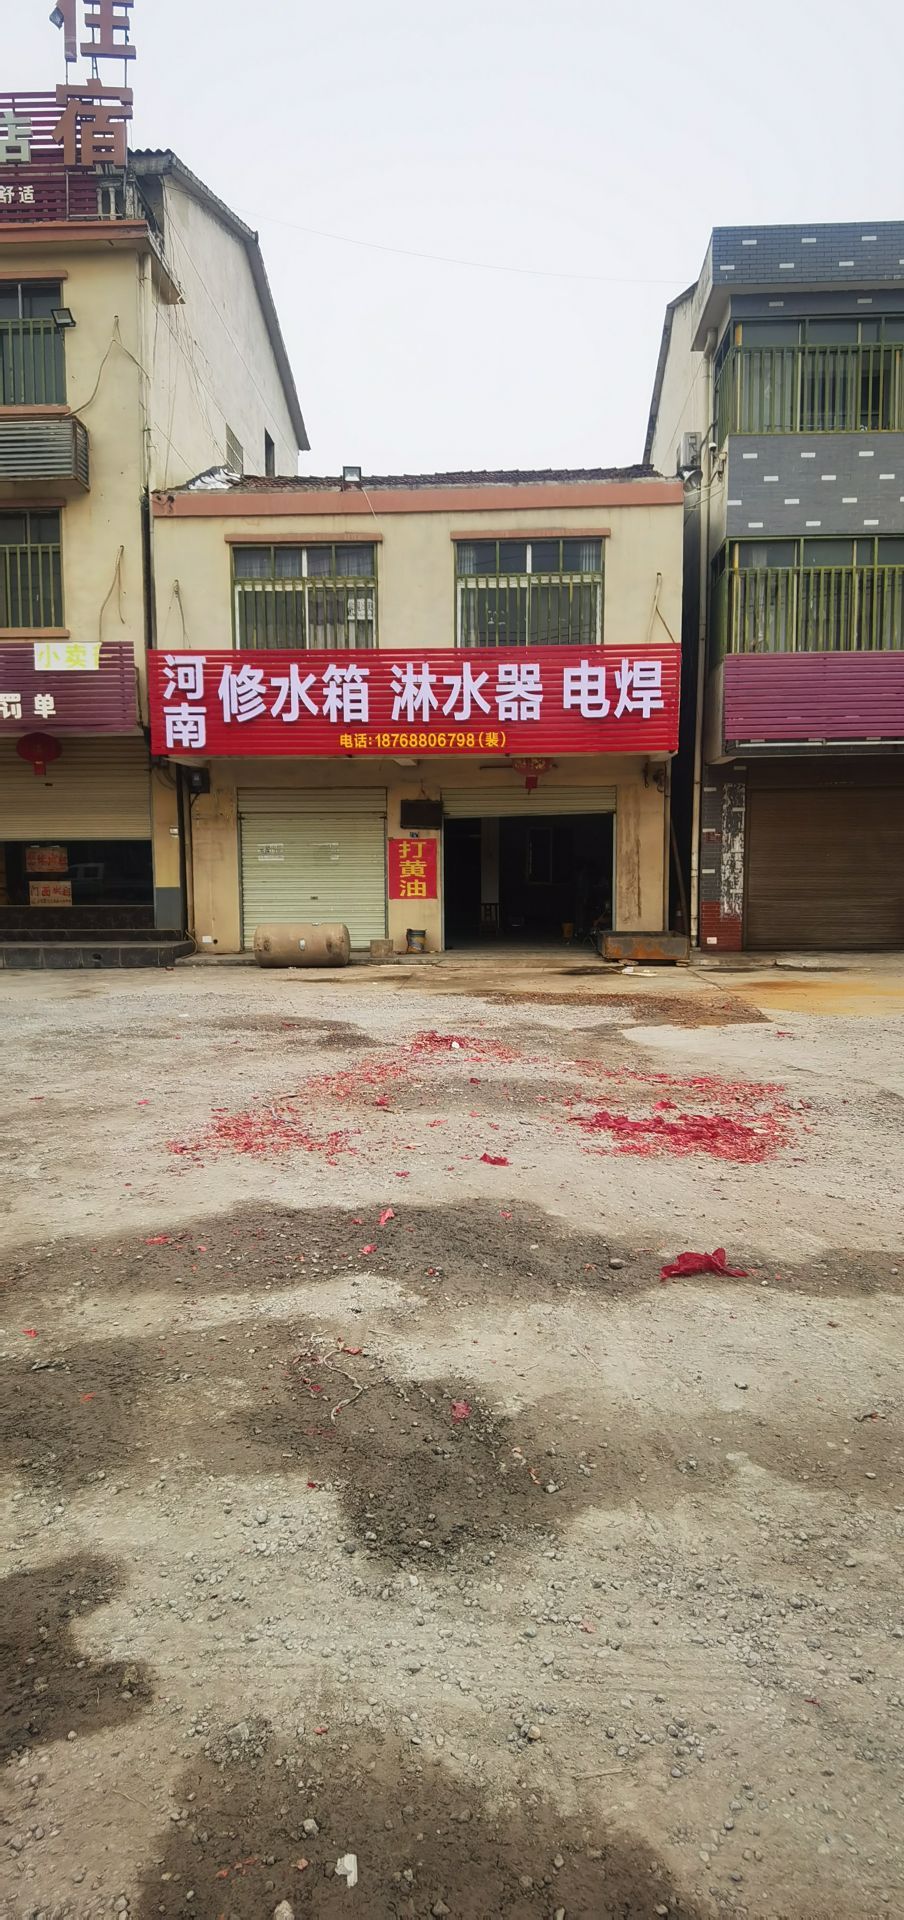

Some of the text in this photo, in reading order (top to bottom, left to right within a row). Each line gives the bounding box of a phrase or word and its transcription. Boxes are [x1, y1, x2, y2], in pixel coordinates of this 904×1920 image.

[37, 643, 99, 669] 小卖
[163, 654, 207, 749] 河南
[218, 658, 665, 723] 修水箱 淋水器 电焊
[398, 840, 427, 897] 打黄油
